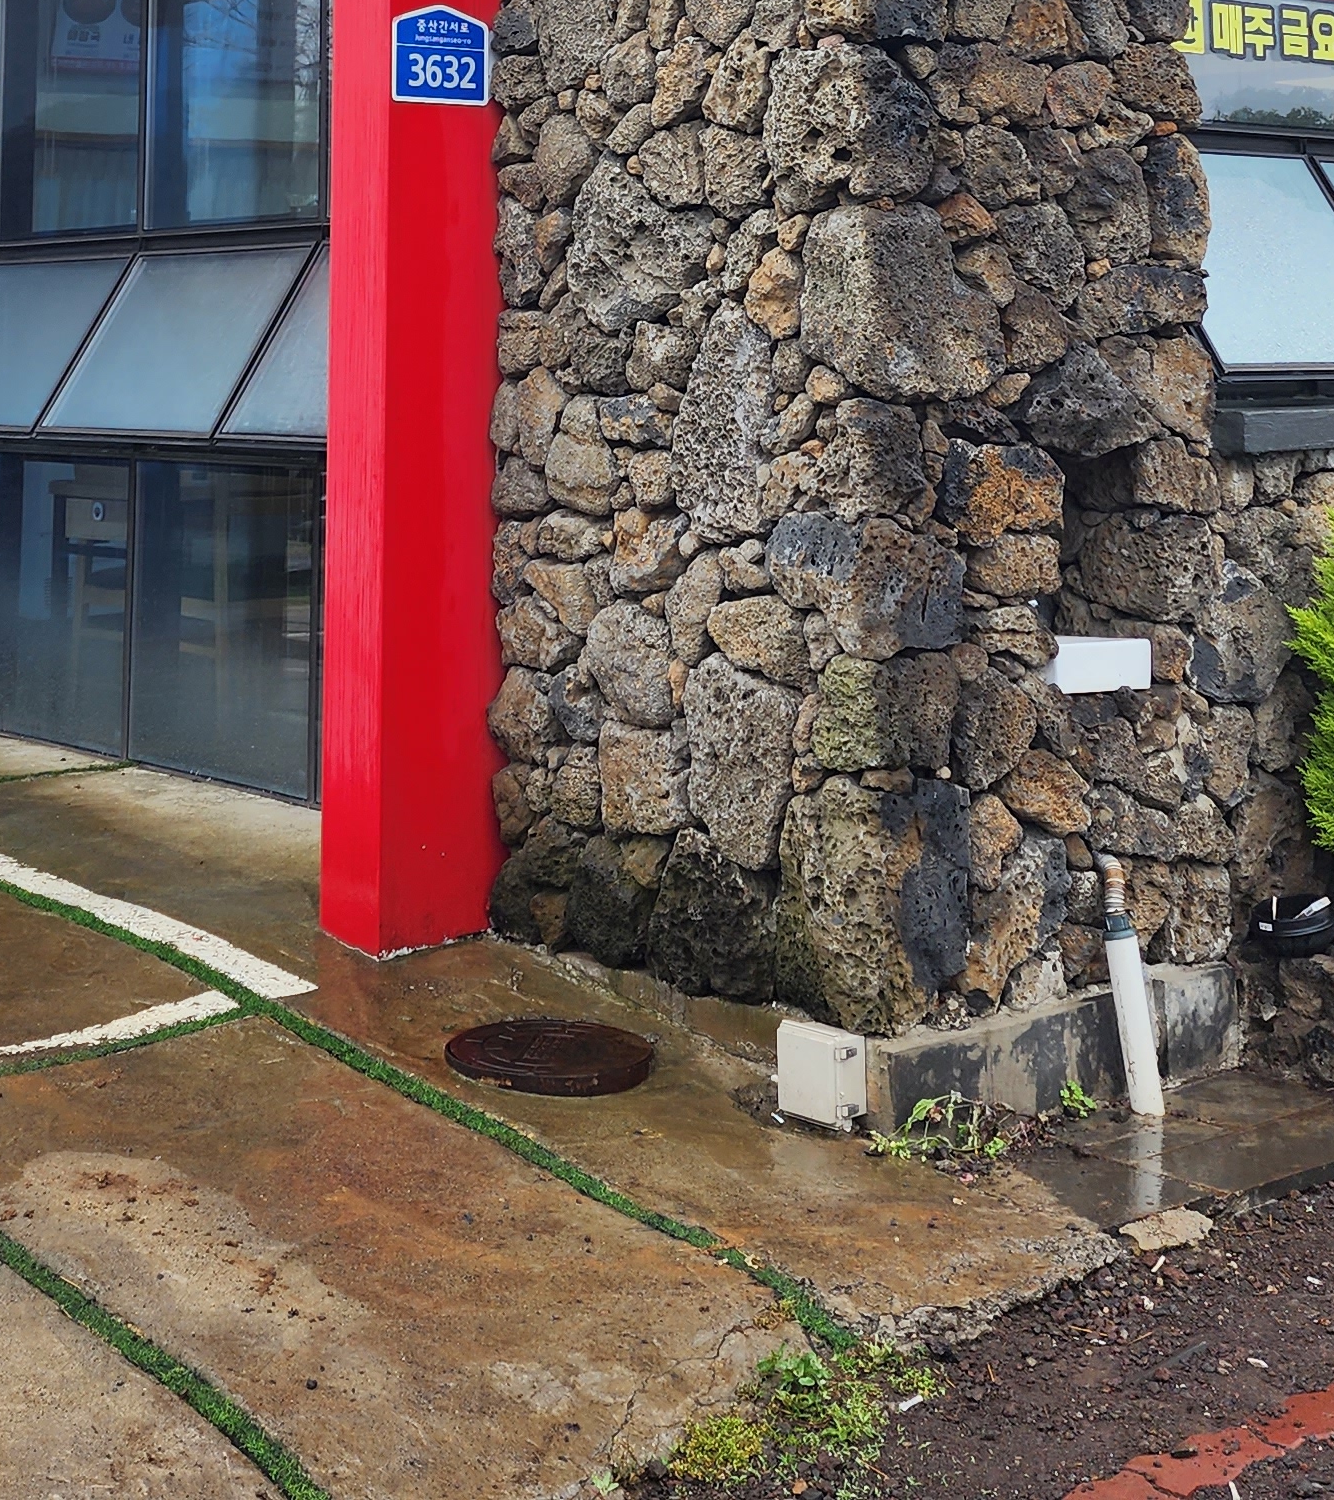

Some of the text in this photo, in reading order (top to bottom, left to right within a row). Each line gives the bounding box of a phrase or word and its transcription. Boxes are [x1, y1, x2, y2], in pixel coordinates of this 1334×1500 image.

[416, 19, 470, 33] 중산간서로
[1211, 2, 1275, 57] 매주
[408, 53, 477, 89] 3632
